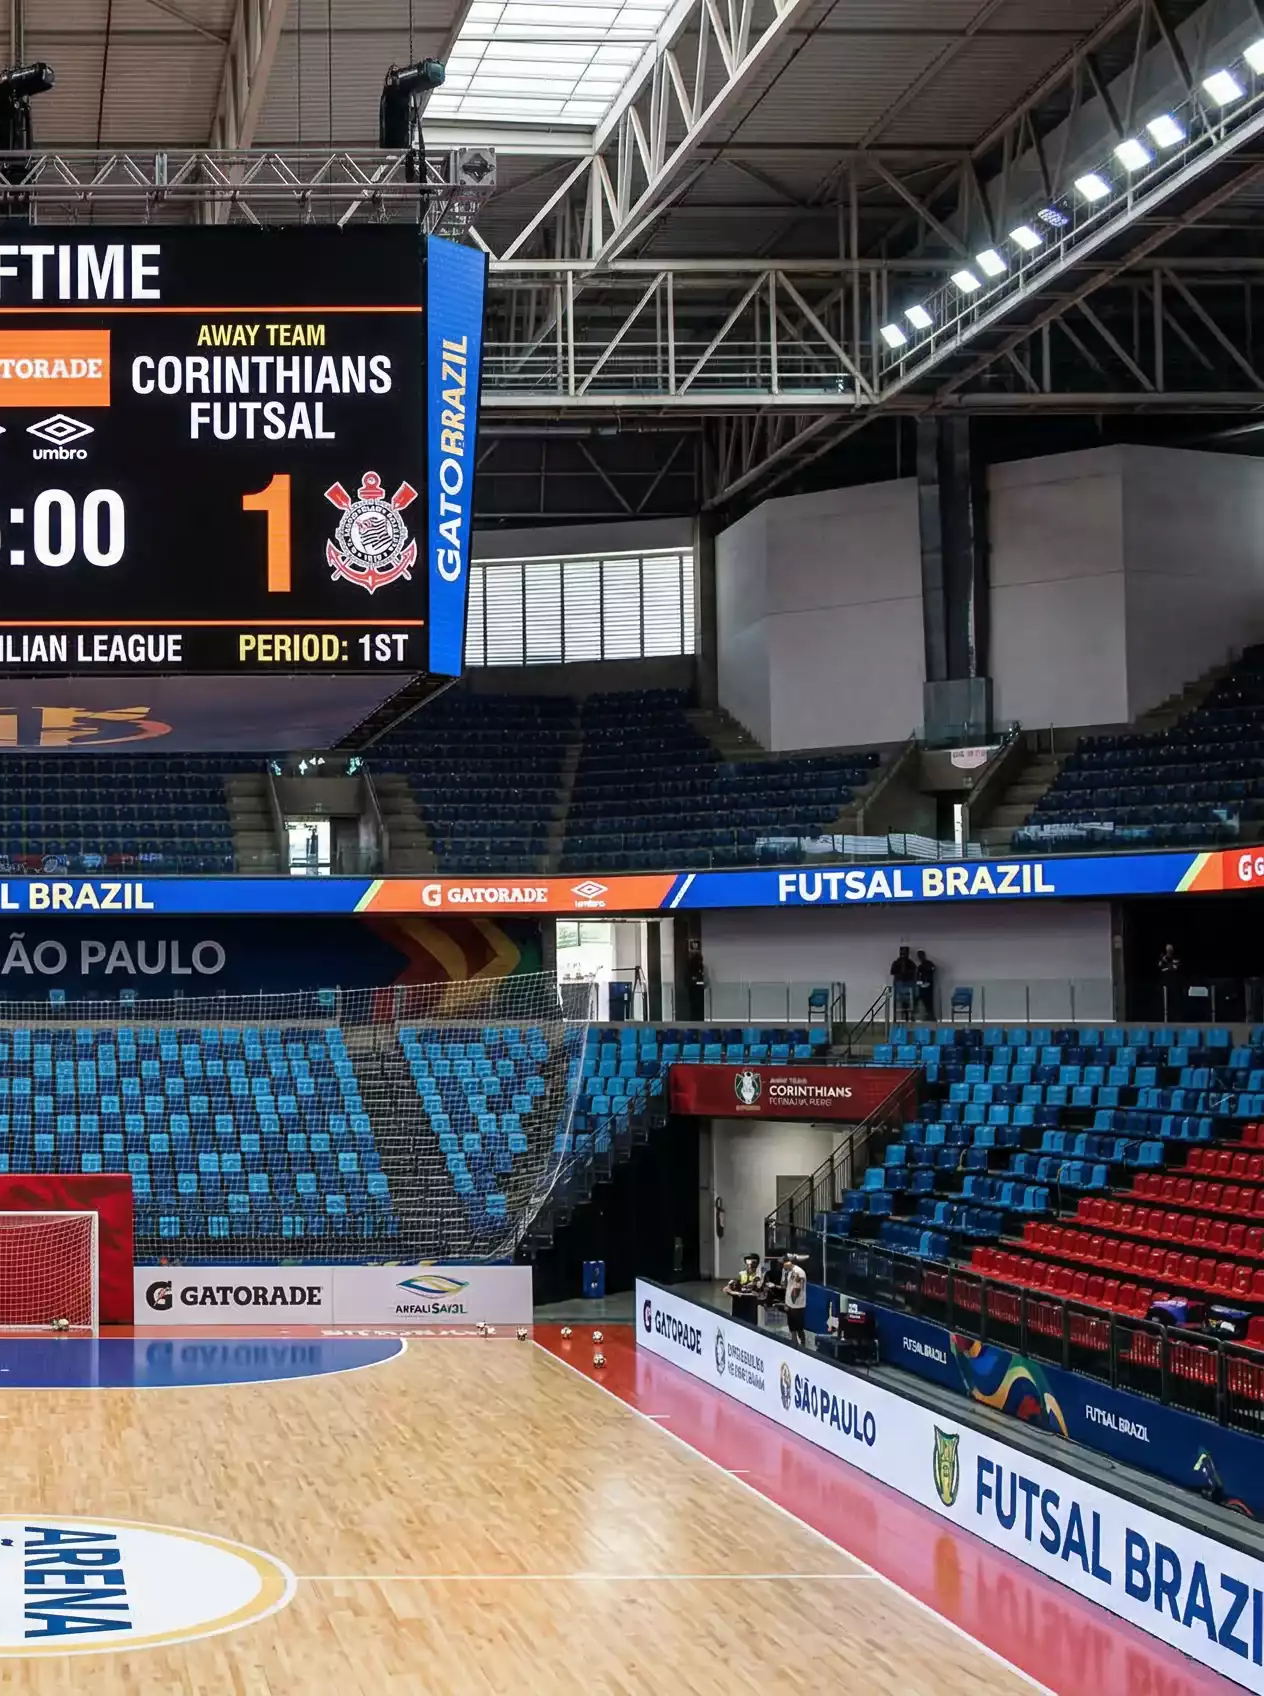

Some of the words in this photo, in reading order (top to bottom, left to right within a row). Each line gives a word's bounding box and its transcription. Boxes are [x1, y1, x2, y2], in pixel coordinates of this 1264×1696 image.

[197, 324, 259, 346] AWAY
[266, 324, 325, 346] TEAM
[132, 355, 392, 394] CORINTHIANS
[190, 401, 335, 440] FUTSAL
[32, 446, 87, 460] umbro
[242, 474, 291, 592] 1
[78, 634, 182, 662] LEAGUE
[239, 634, 348, 662] PERIOD:
[358, 634, 408, 661] 1ST
[29, 883, 154, 909] BRAZIL
[448, 887, 548, 903] GATORADE
[778, 869, 913, 902] FUTSAL
[922, 864, 1055, 897] BRAZIL
[81, 940, 226, 975] PAULO
[769, 1085, 852, 1098] CORINTHIANS
[180, 1286, 323, 1306] GATORADE
[820, 1389, 876, 1447] PAULO
[976, 1455, 1112, 1585] FUTSAL
[1124, 1527, 1264, 1667] BRAZI
[24, 1526, 133, 1639] ARENA
